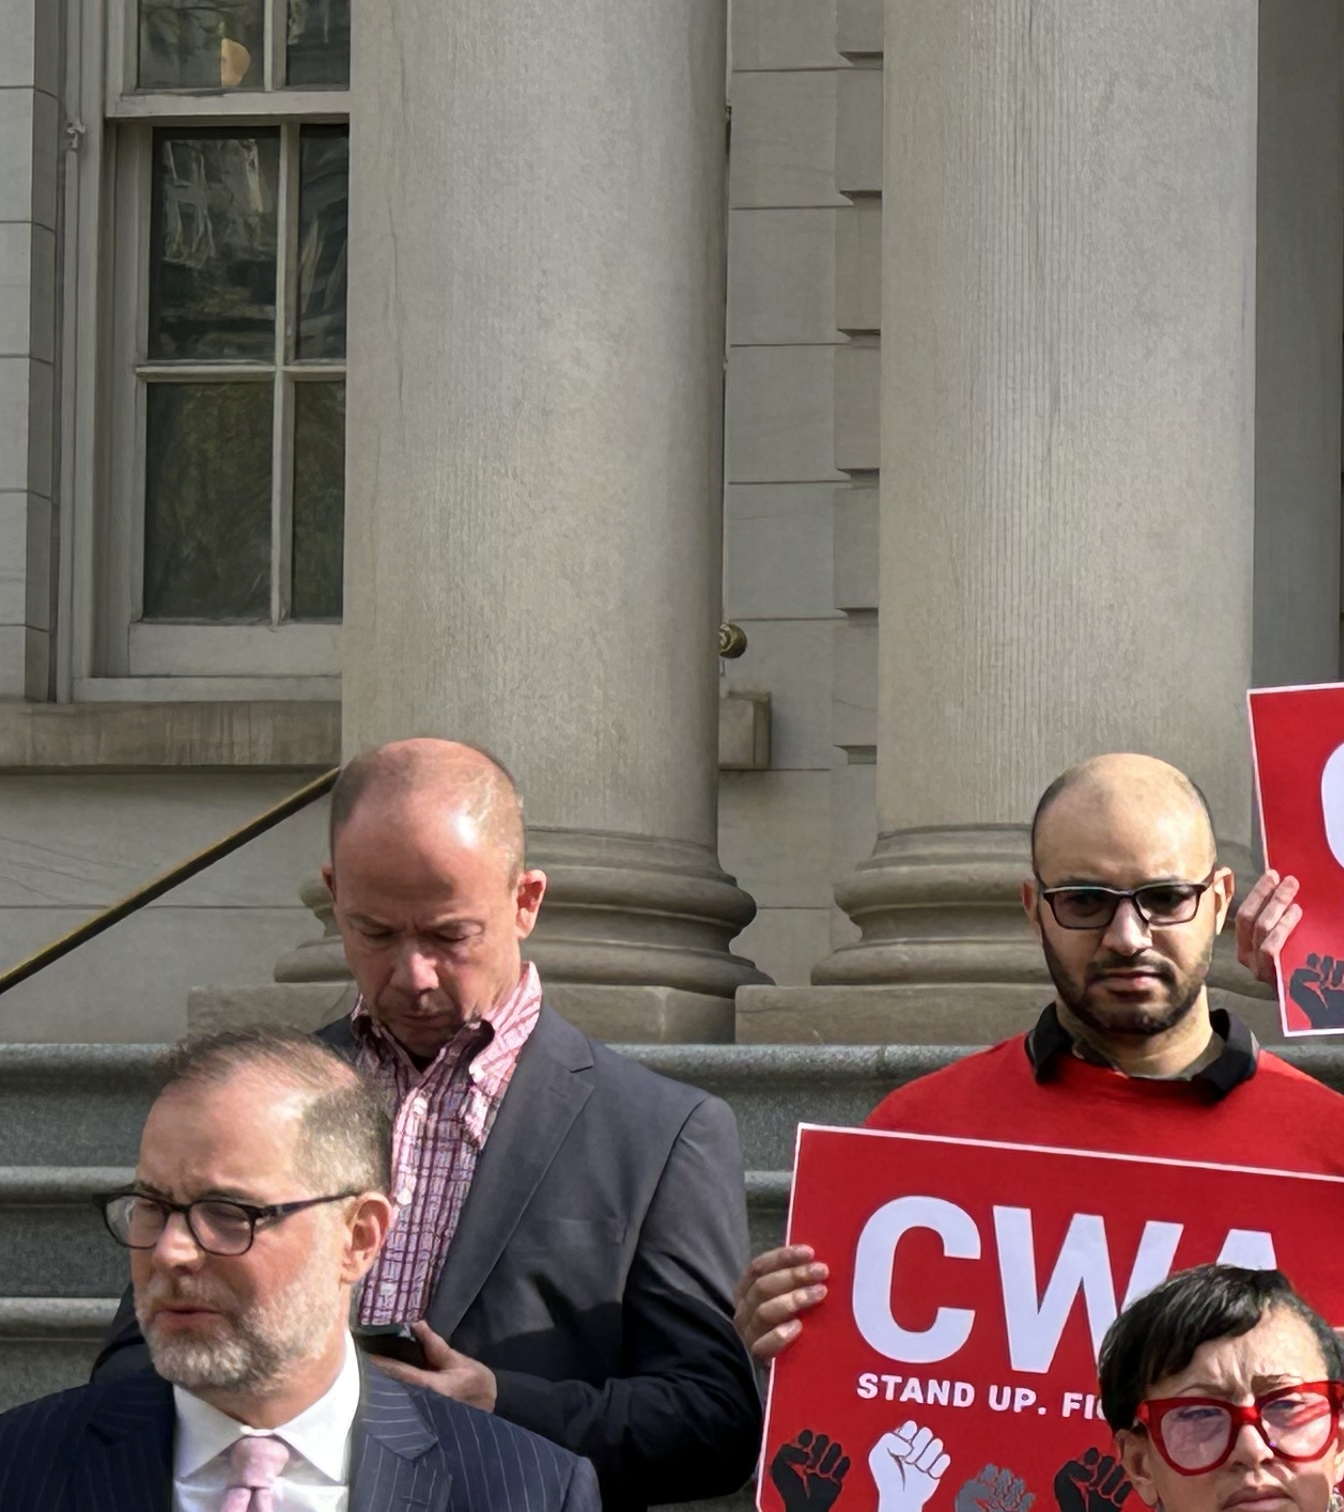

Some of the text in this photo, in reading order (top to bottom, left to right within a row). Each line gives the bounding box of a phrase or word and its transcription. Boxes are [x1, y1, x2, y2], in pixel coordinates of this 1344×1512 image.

[852, 1195, 1278, 1374] CW
[857, 1372, 976, 1408] STAND
[987, 1384, 1048, 1414] UP.
